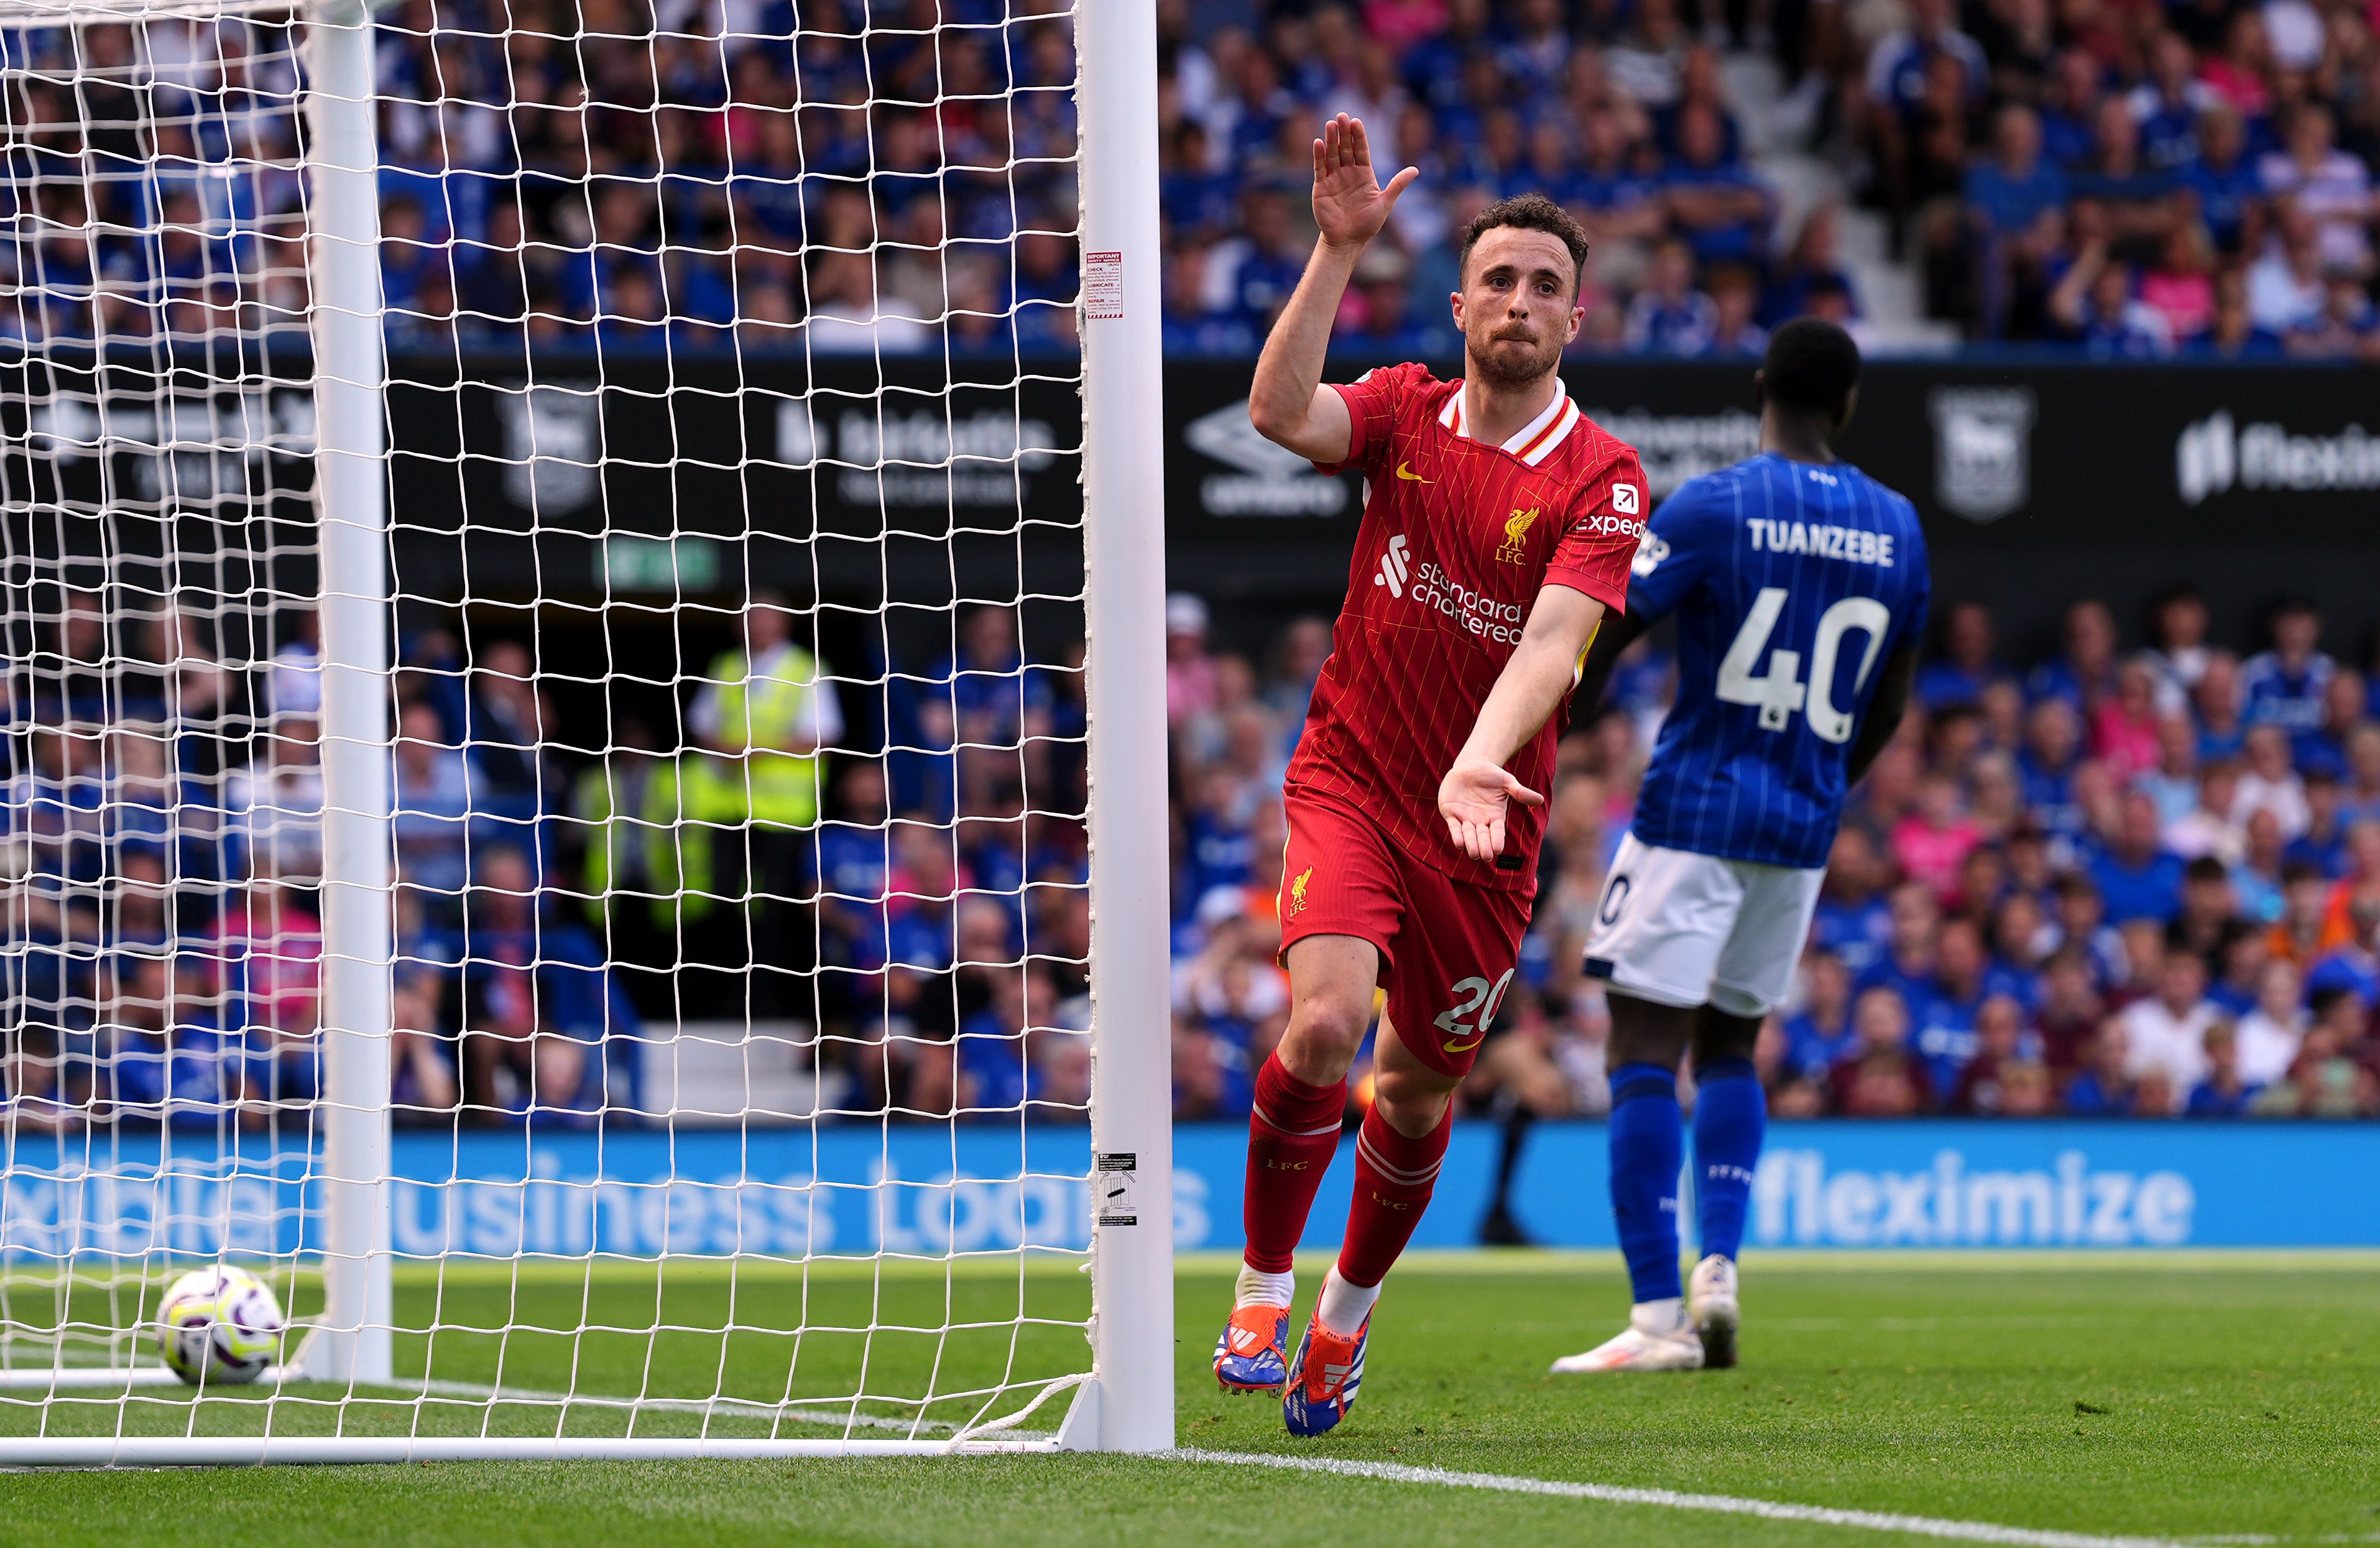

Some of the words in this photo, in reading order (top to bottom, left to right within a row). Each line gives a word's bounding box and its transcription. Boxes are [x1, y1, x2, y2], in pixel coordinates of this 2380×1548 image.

[1495, 548, 1526, 566] L.F.C.
[1746, 518, 1894, 568] TUANZEBE
[1418, 562, 1521, 623] standard
[1715, 587, 1891, 744] 40
[1433, 967, 1515, 1036] 20
[1266, 1158, 1308, 1171] LFC
[316, 1153, 836, 1257] usiness
[1372, 1191, 1408, 1210] LFC
[1753, 1149, 2197, 1246] fleximize
